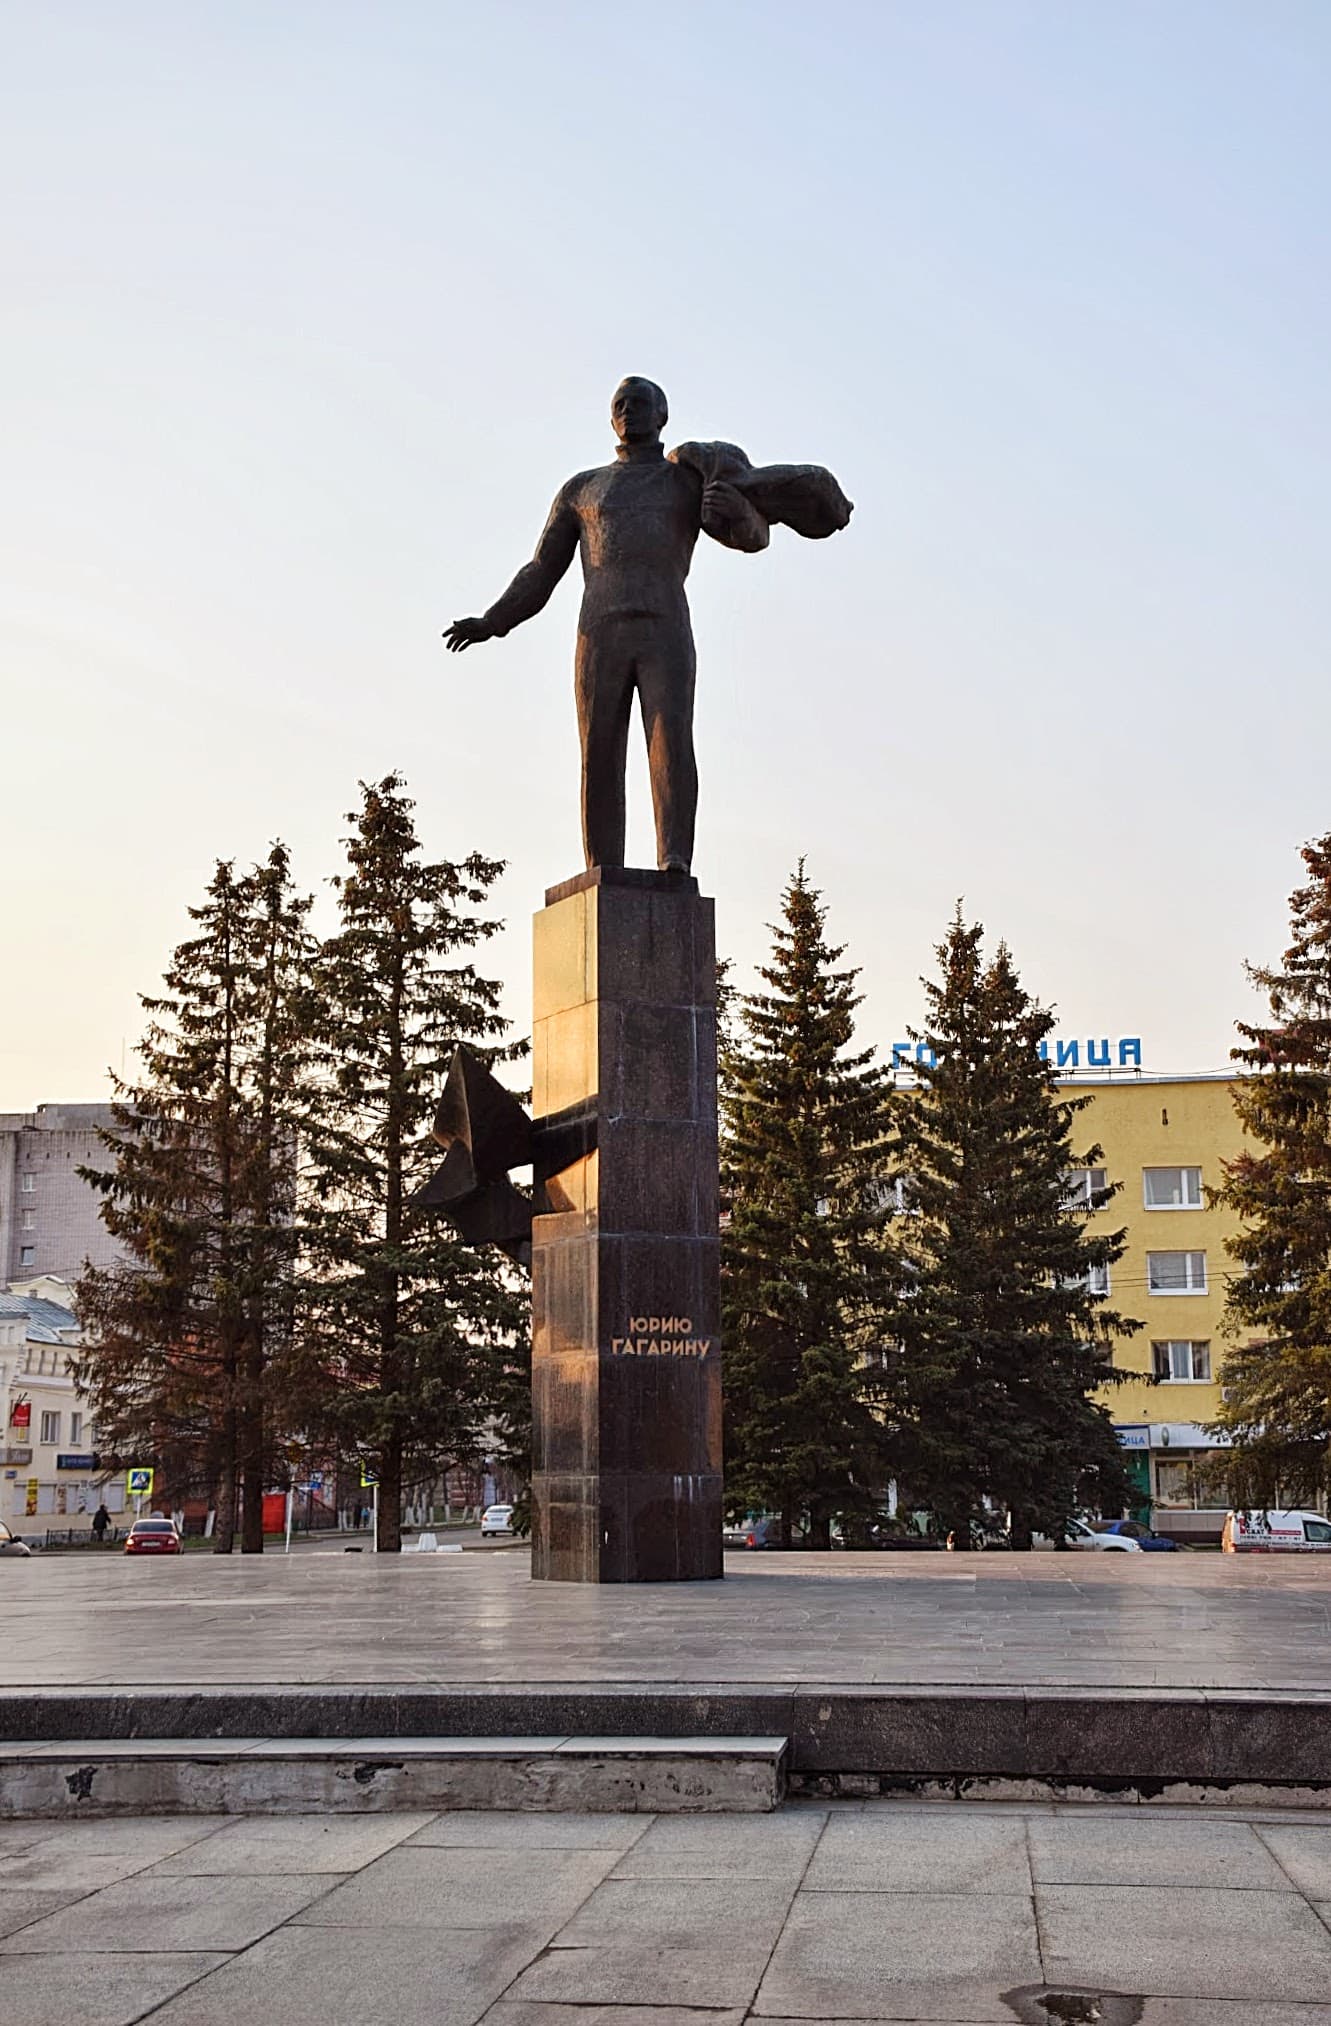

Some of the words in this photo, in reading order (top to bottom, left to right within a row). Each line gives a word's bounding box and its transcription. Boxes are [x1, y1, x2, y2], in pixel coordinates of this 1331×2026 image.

[892, 1038, 1141, 1069] ГОИЦА
[630, 1316, 692, 1333] ЮРИЮ
[612, 1339, 710, 1359] ГАГАРИНУ
